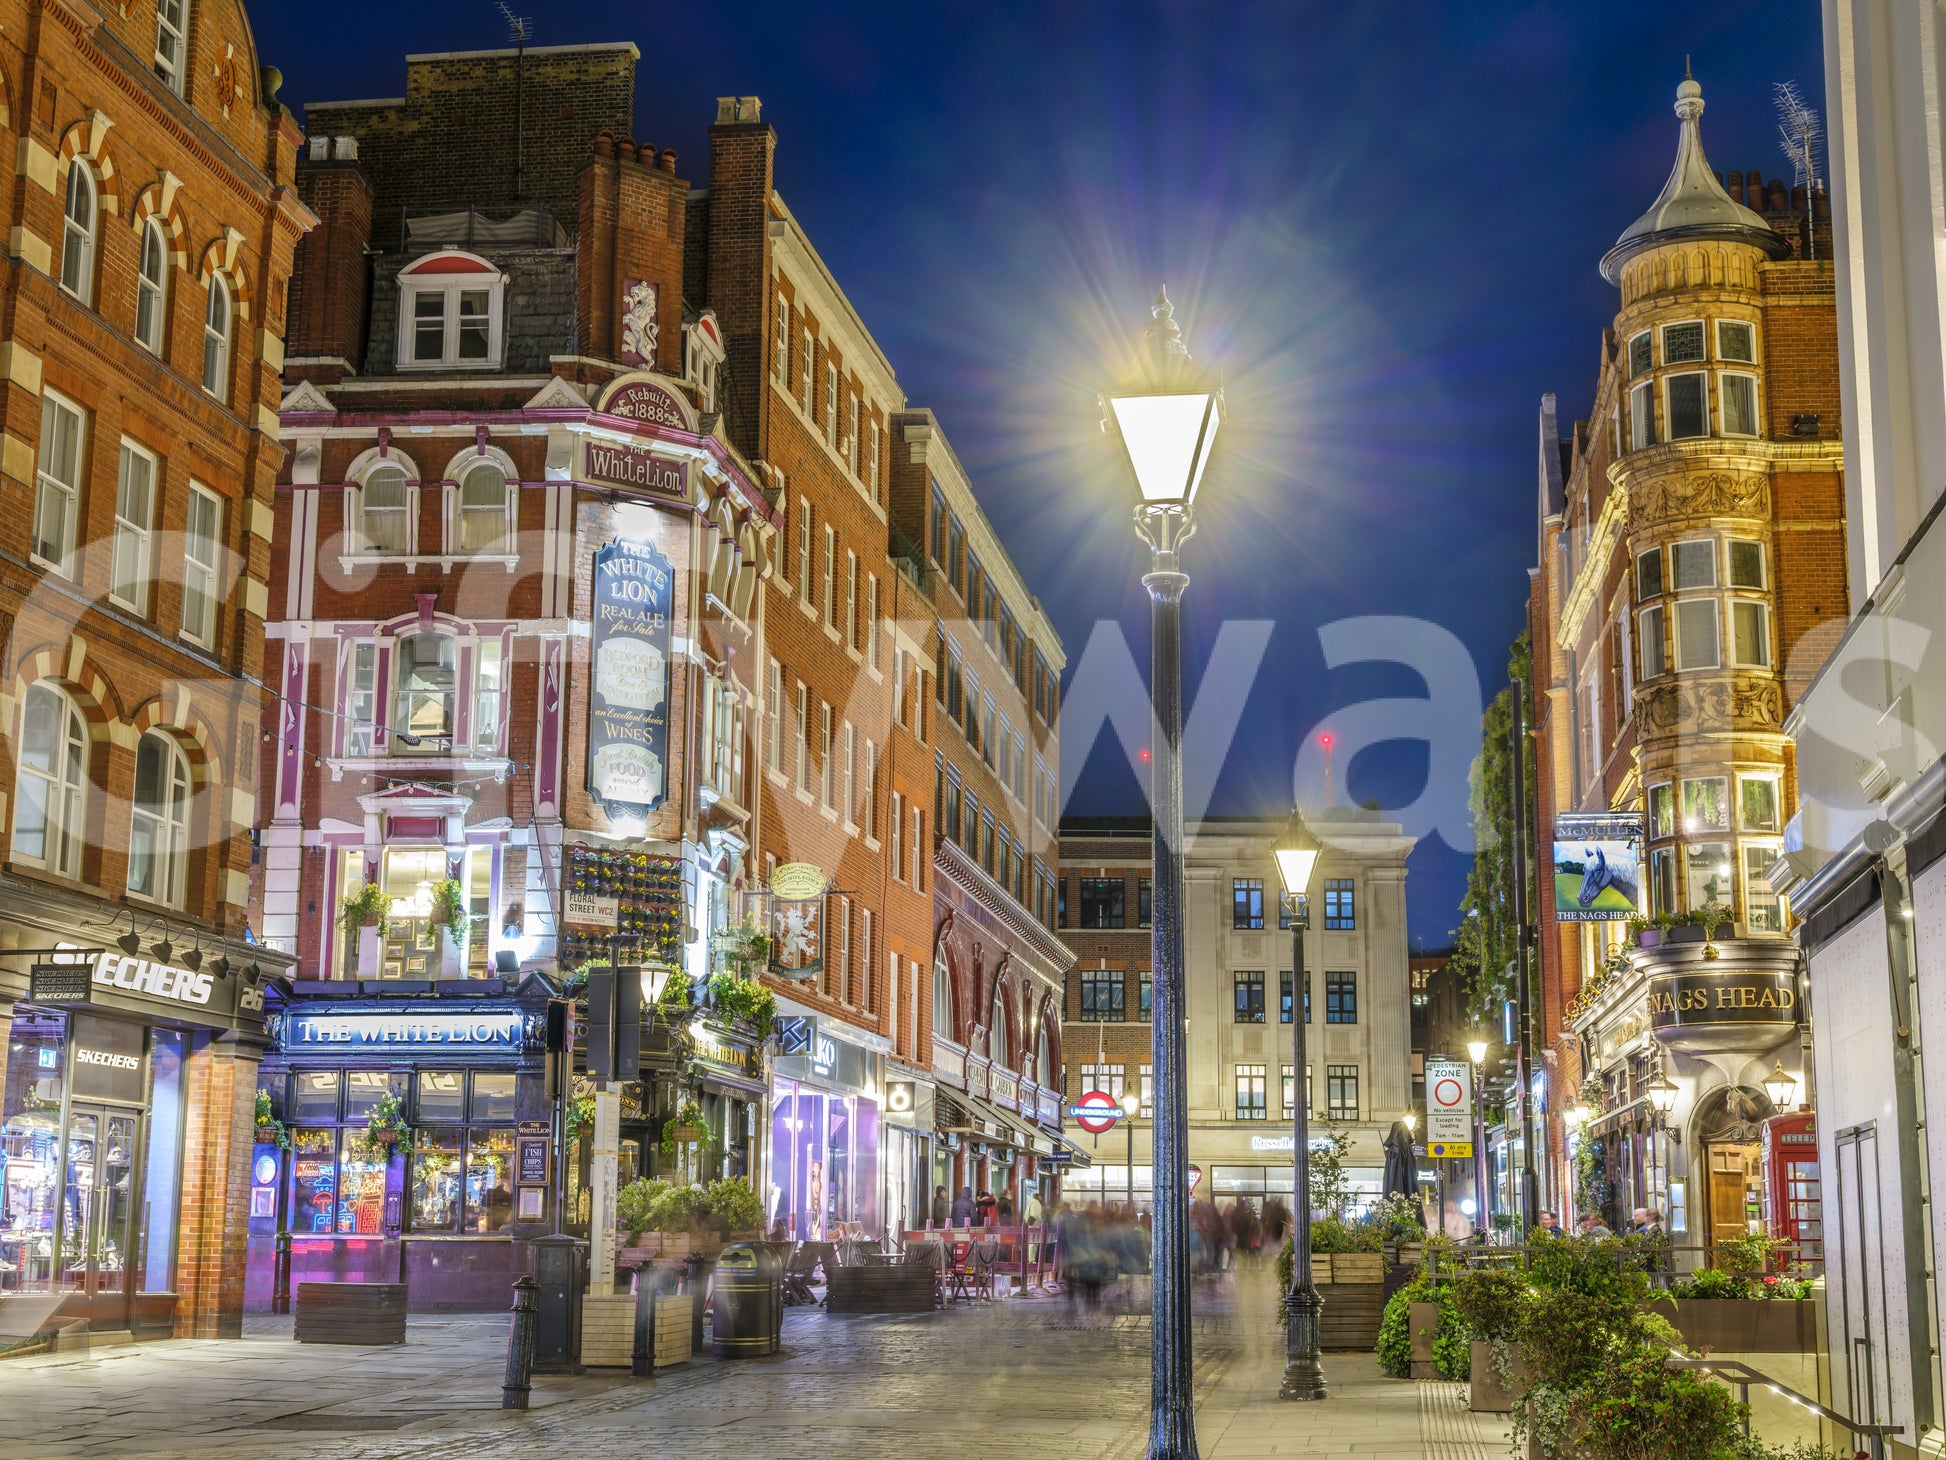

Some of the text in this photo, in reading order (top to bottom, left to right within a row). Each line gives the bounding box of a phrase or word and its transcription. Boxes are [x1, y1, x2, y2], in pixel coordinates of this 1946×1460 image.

[627, 388, 671, 410] Rebuilt
[635, 403, 664, 422] 1888
[629, 445, 647, 455] THE
[621, 541, 651, 559] THE
[600, 558, 668, 589] WHITE
[611, 580, 657, 606] LION
[601, 604, 664, 628] REAL ALE
[609, 619, 655, 636] for Sale
[604, 648, 659, 670] BEDFORD
[613, 663, 648, 677] ROOM
[594, 706, 664, 726] an Excellent choice
[604, 720, 653, 745] WINES
[610, 762, 646, 777] FOOD
[1558, 826, 1644, 835] McMULLEN
[777, 875, 819, 887] NICHOLSON'S
[570, 894, 595, 904] FLORAL
[569, 904, 614, 916] STREET WC2
[1557, 912, 1638, 920] THE NAGS HEAD
[52, 942, 214, 1004] SKECHERS
[241, 987, 264, 1011] 26
[1650, 988, 1708, 1013] NAGS
[1715, 987, 1795, 1009] HEAD
[298, 1022, 514, 1042] THE WHITE LION
[77, 1049, 139, 1069] SKECHERS
[730, 1047, 746, 1068] LION
[1070, 1107, 1123, 1117] UNDERGROUND
[525, 1148, 542, 1157] FISH
[1252, 1136, 1289, 1150] Russell
